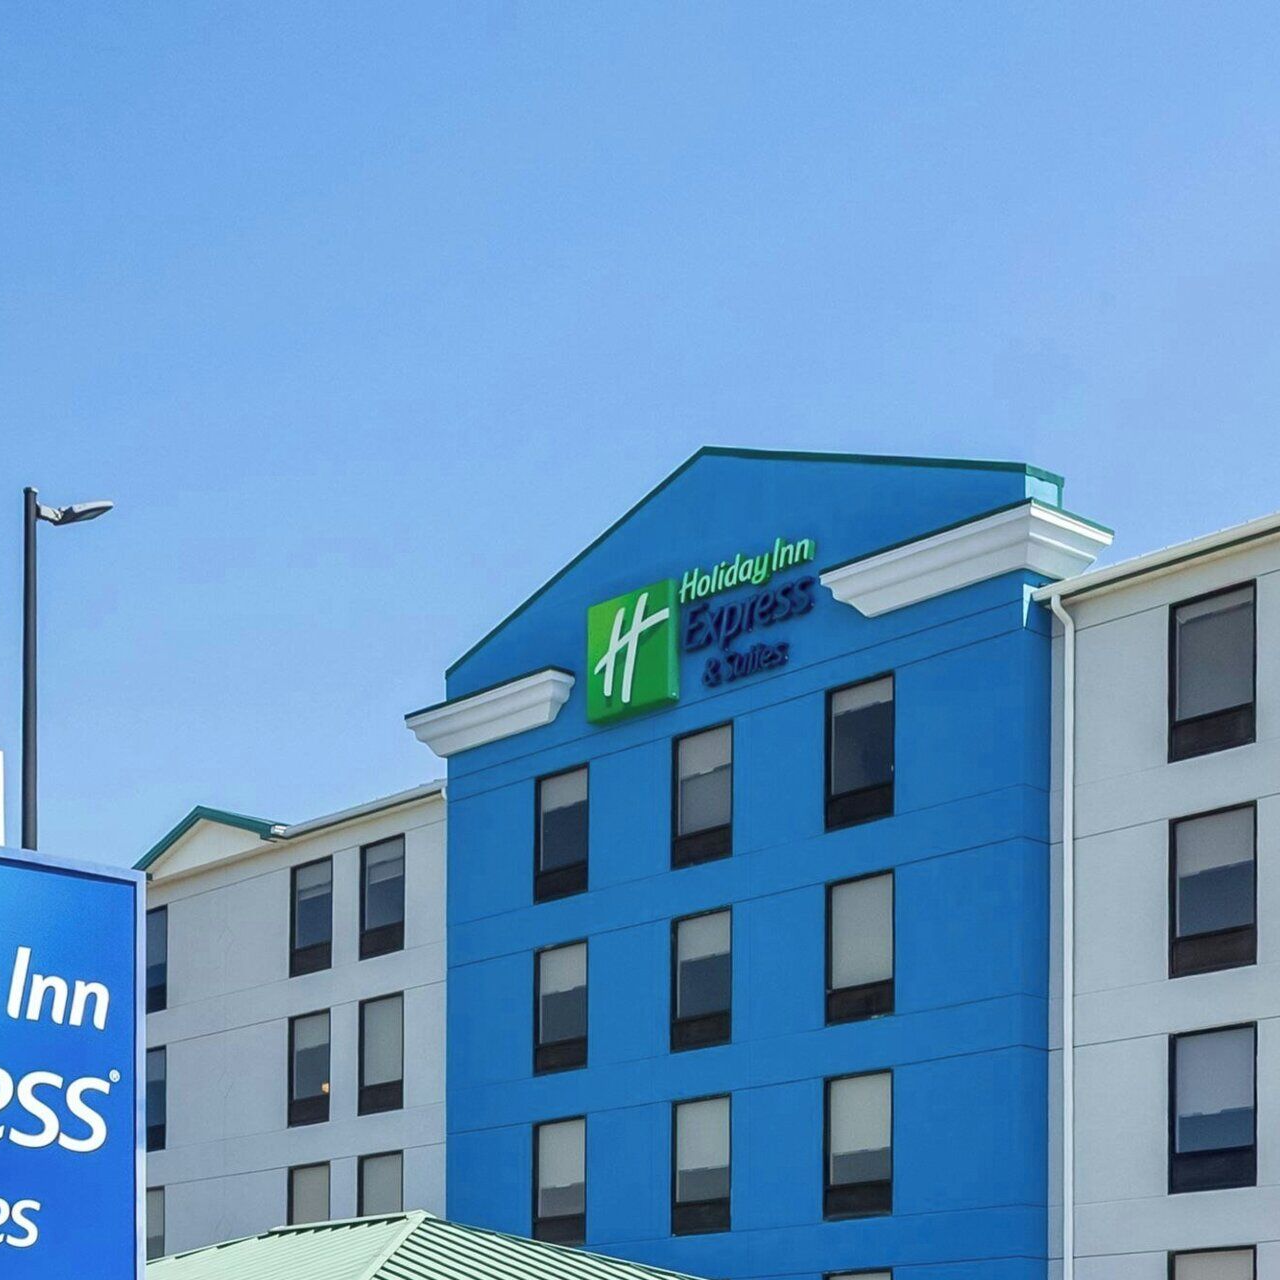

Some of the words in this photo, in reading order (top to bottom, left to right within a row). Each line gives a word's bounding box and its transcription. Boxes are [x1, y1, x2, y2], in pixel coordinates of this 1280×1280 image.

[678, 552, 769, 604] Holiday
[772, 537, 815, 572] Inn
[683, 576, 816, 655] Express
[703, 657, 723, 687] &
[727, 641, 790, 683] Suites
[7, 946, 110, 1031] Inn
